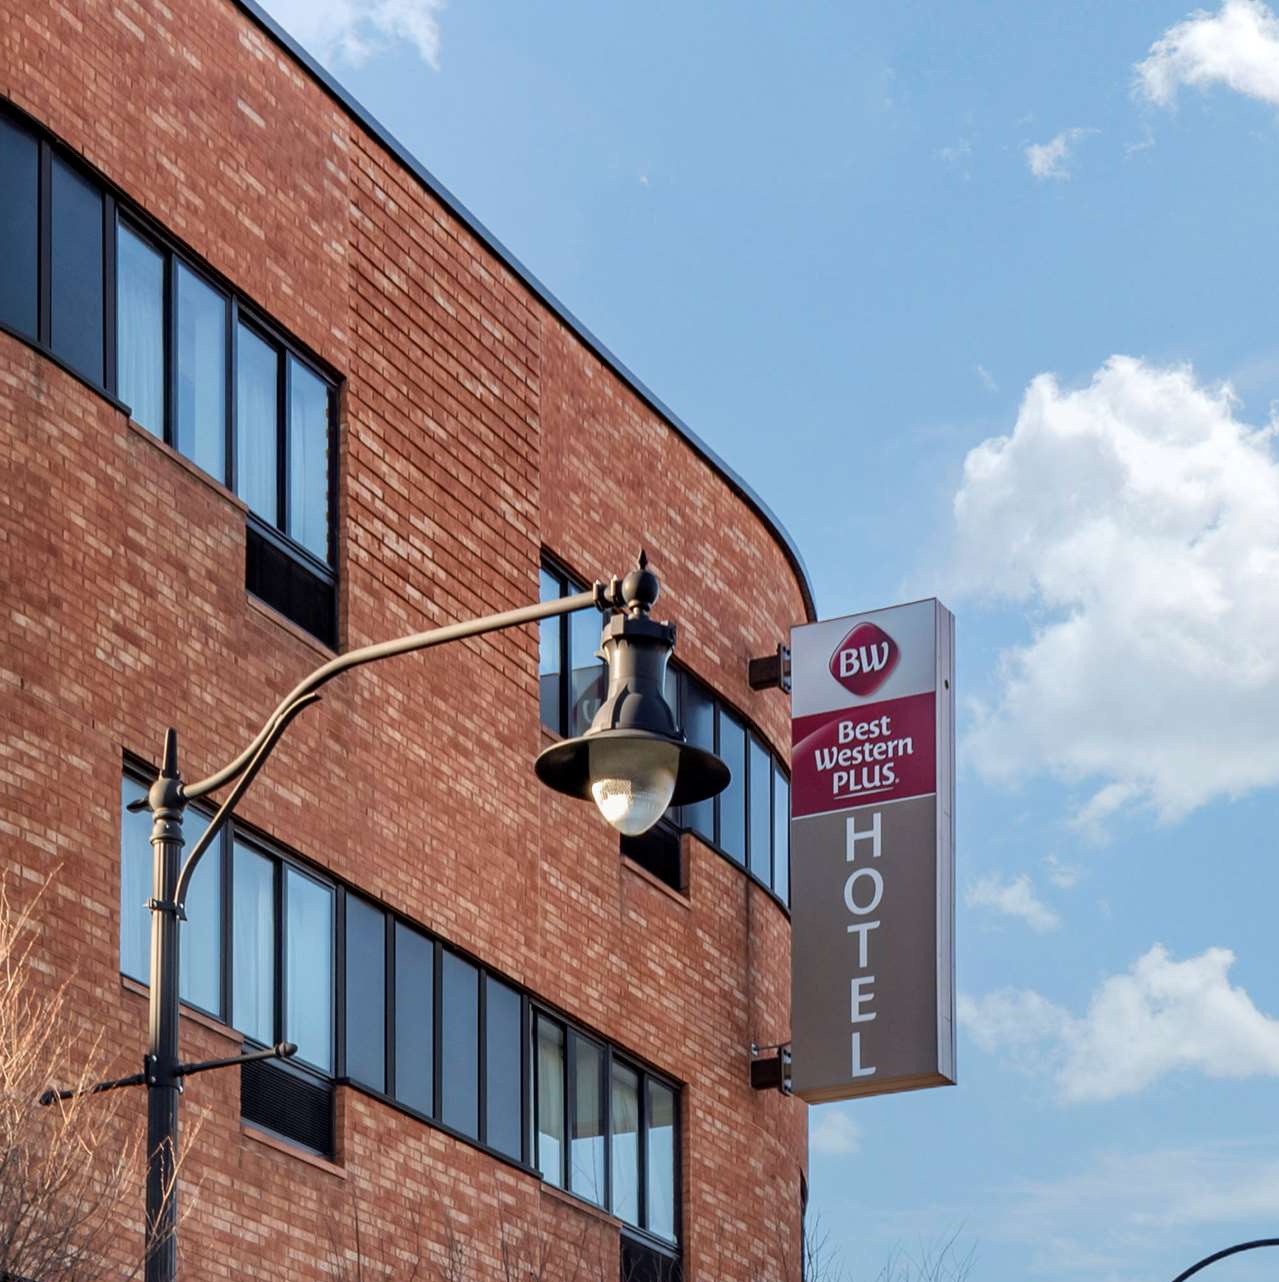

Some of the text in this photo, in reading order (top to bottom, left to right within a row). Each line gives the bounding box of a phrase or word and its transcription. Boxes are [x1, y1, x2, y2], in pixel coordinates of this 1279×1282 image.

[839, 642, 889, 678] BW
[838, 715, 891, 744] Best
[814, 737, 913, 771] Western
[844, 812, 884, 1078] HOTEL
